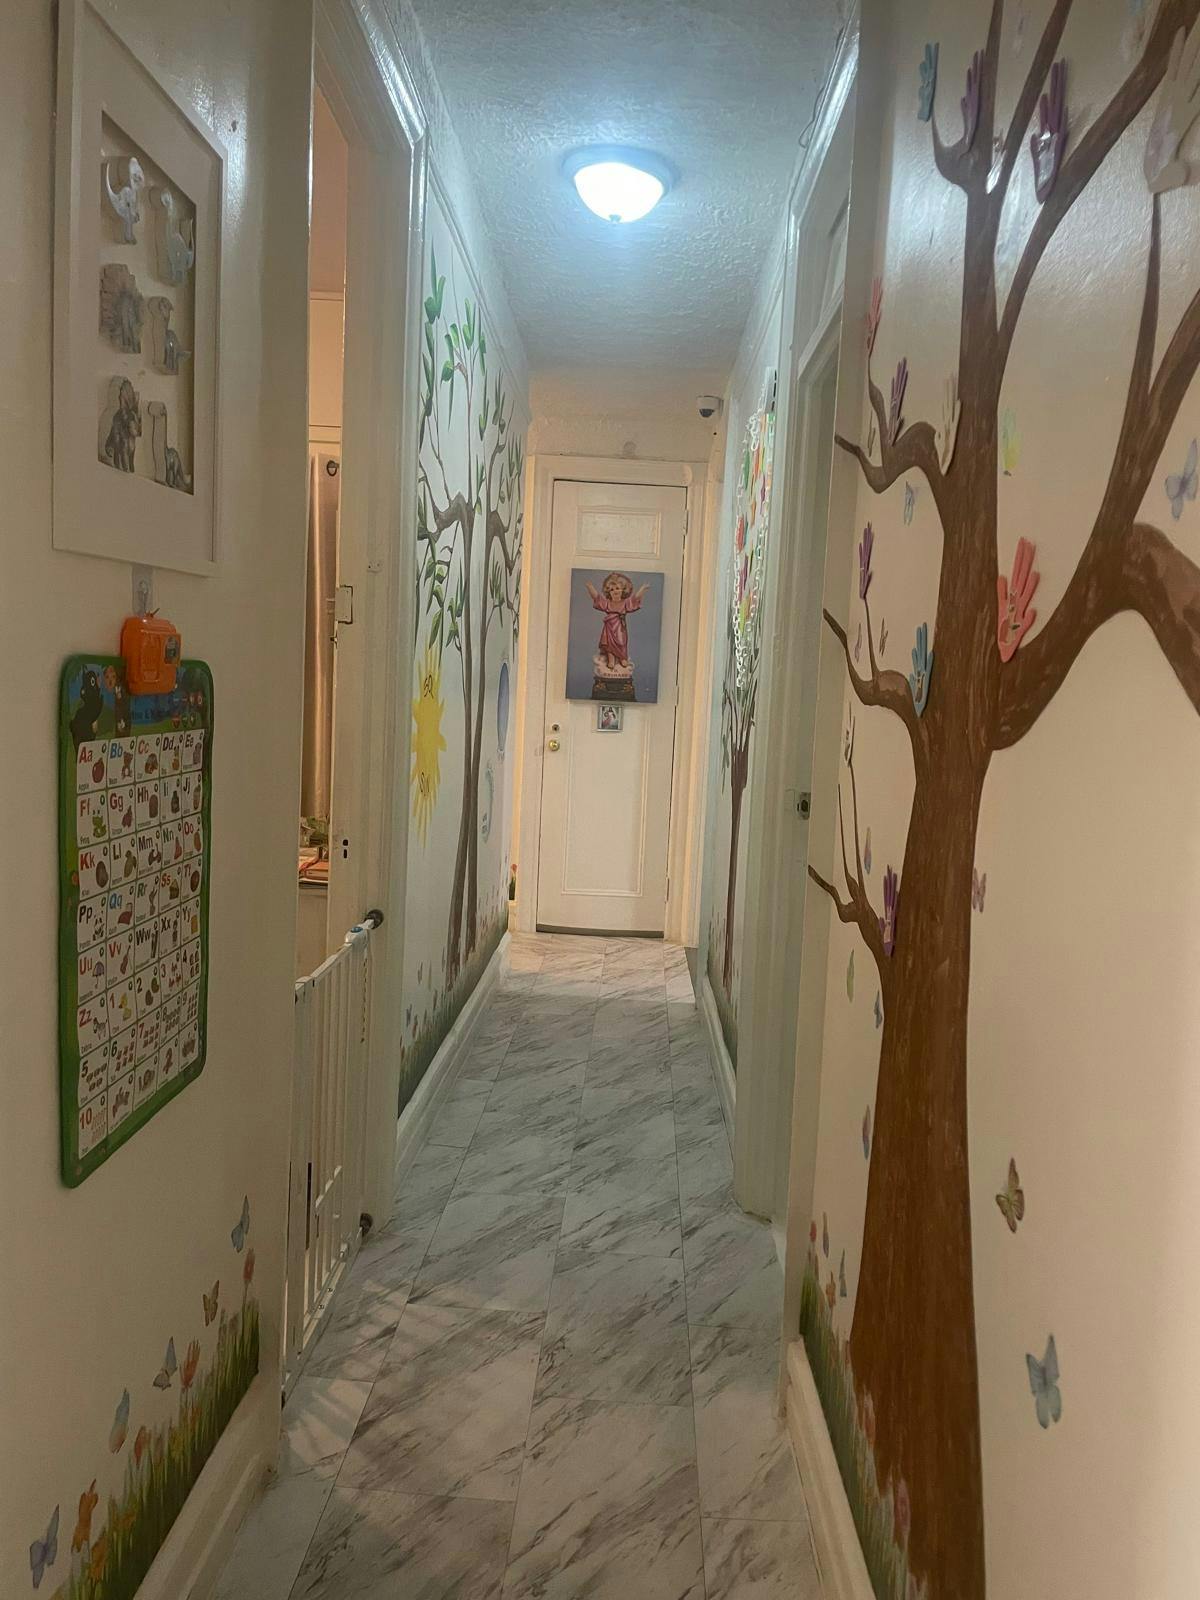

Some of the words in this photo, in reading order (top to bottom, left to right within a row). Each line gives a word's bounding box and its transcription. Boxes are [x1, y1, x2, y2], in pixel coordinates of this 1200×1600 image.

[138, 740, 149, 754] Cc
[163, 737, 174, 751] Dd
[185, 734, 194, 747] Ee
[79, 746, 92, 763] Aa
[110, 742, 123, 758] Bb
[163, 782, 168, 796] Ii
[183, 777, 190, 794] Jj
[110, 793, 123, 811] Gg
[137, 787, 149, 803] Hh
[80, 798, 90, 817] Ff
[163, 828, 174, 842] Nn
[184, 821, 194, 835] Oo
[113, 843, 121, 860] Ll
[139, 836, 153, 851] Mm
[80, 853, 95, 870] Kk
[184, 864, 191, 877] Tt
[161, 873, 171, 887] Ss
[137, 882, 147, 898] Rr
[110, 893, 122, 909] Qq
[79, 905, 93, 924] Pp
[183, 906, 192, 922] Yy
[161, 917, 171, 932] Xx
[136, 928, 151, 945] Ww
[109, 941, 122, 958] Vv
[79, 957, 92, 975] Uu
[161, 964, 166, 978] 3
[136, 977, 142, 993] 2
[110, 993, 115, 1008] 1
[79, 1008, 92, 1027] Zz
[138, 1022, 145, 1038] 7
[111, 1041, 117, 1057] 6
[81, 1060, 88, 1078] 5
[80, 1108, 92, 1129] 10
